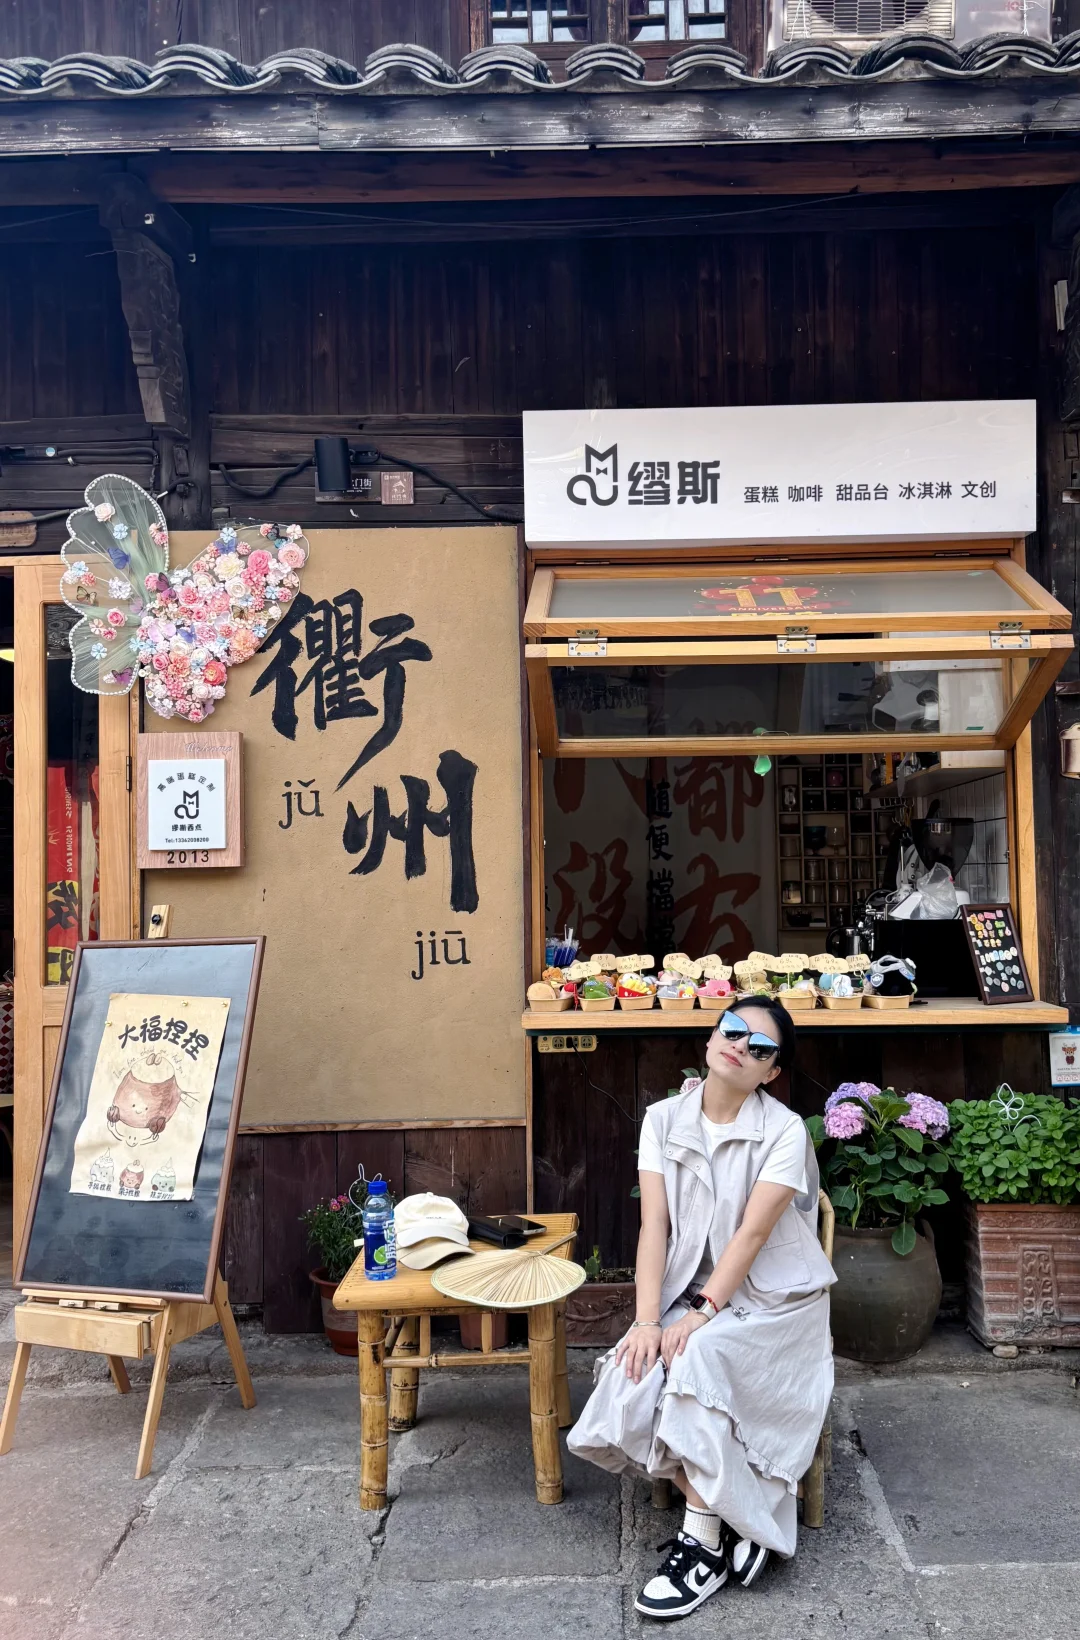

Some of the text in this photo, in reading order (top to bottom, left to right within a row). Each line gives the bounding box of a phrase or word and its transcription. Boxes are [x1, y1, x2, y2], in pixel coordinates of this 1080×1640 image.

[628, 460, 720, 506] 缪斯
[743, 481, 997, 503] 蛋糕 咖啡 甜品台 冰淇淋 文创
[719, 587, 803, 607] 11
[728, 604, 819, 612] ANNIVERSARY
[167, 849, 209, 864] 2013
[411, 930, 471, 980] jiū
[118, 1015, 209, 1061] 大福捏捏
